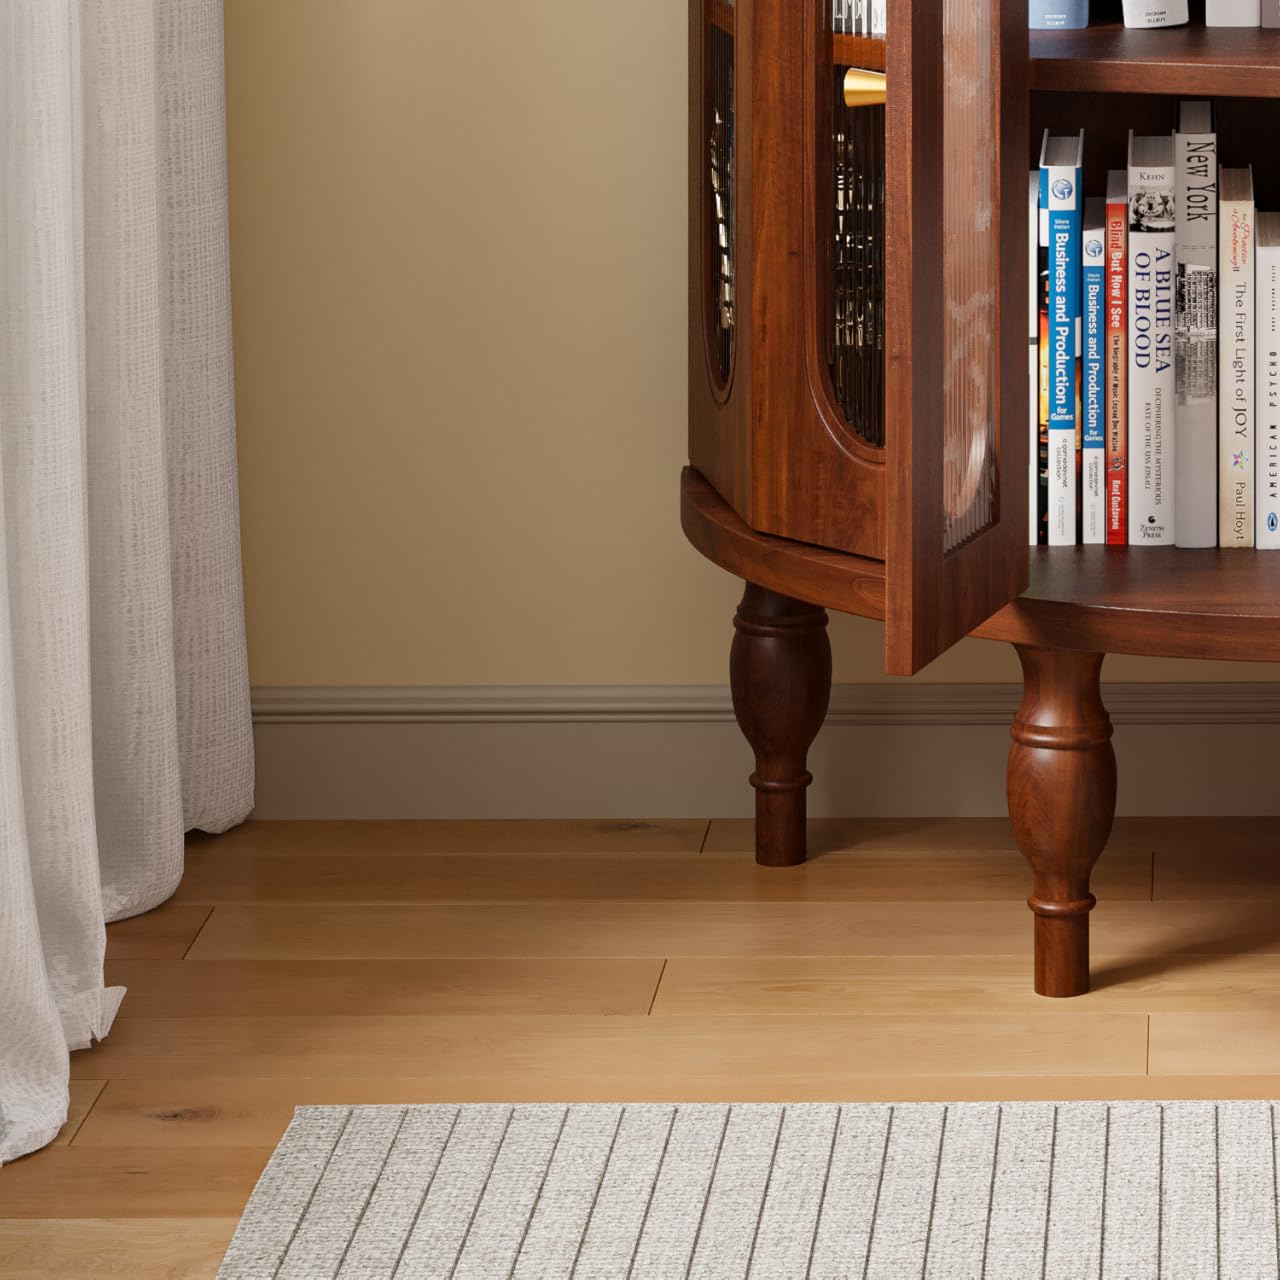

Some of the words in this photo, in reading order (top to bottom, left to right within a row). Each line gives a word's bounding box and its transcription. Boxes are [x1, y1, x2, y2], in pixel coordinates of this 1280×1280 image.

[1186, 141, 1216, 178] New
[1186, 182, 1216, 222] York
[1110, 220, 1122, 249] Blind
[1055, 233, 1069, 293] Business
[1111, 252, 1122, 272] But
[1134, 252, 1151, 282] OF
[1155, 247, 1171, 263] A
[1110, 274, 1121, 297] Now
[1155, 269, 1171, 328] BLUE
[1235, 281, 1247, 308] The
[1055, 295, 1070, 322] and
[1088, 284, 1100, 335] Business
[1111, 305, 1121, 328] See
[1134, 288, 1151, 369] BLOOD
[1235, 312, 1247, 343] First
[1088, 336, 1100, 359] and
[1155, 333, 1171, 374] SEA
[1055, 326, 1070, 404] Production
[1232, 347, 1247, 384] Light
[1269, 351, 1278, 407] PSYCHO
[1088, 362, 1100, 428] Production
[1112, 383, 1120, 399] Music
[1235, 388, 1247, 403] of
[1050, 413, 1074, 421] Games
[1056, 406, 1068, 414] for
[1232, 407, 1248, 438] JOY
[1144, 421, 1151, 432] OF
[1268, 424, 1278, 498] AMERICAN
[1235, 482, 1246, 507] Paul
[1233, 511, 1246, 540] Hoyt
